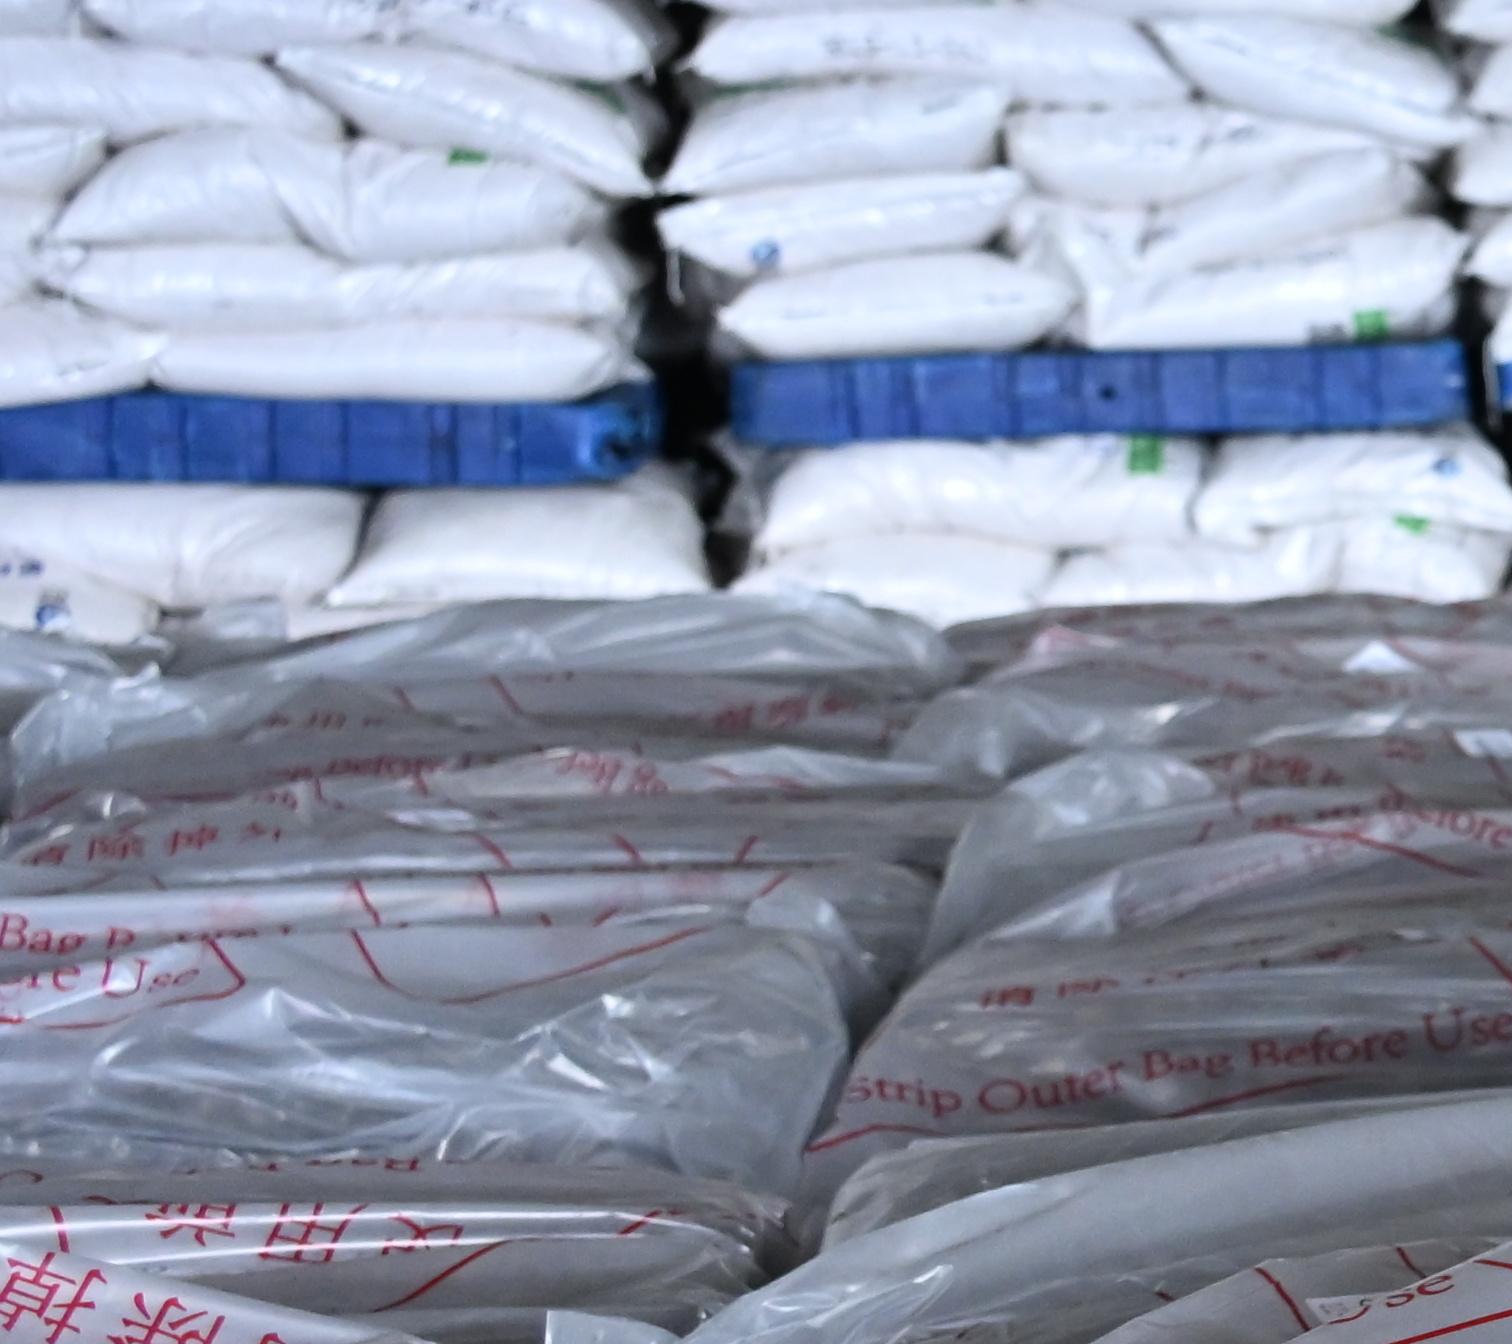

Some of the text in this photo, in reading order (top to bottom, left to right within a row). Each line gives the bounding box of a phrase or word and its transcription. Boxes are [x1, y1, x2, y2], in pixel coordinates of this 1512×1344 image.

[976, 1060, 1126, 1115] Outer
[1142, 1047, 1234, 1083] Bag
[1249, 1024, 1409, 1070] Before
